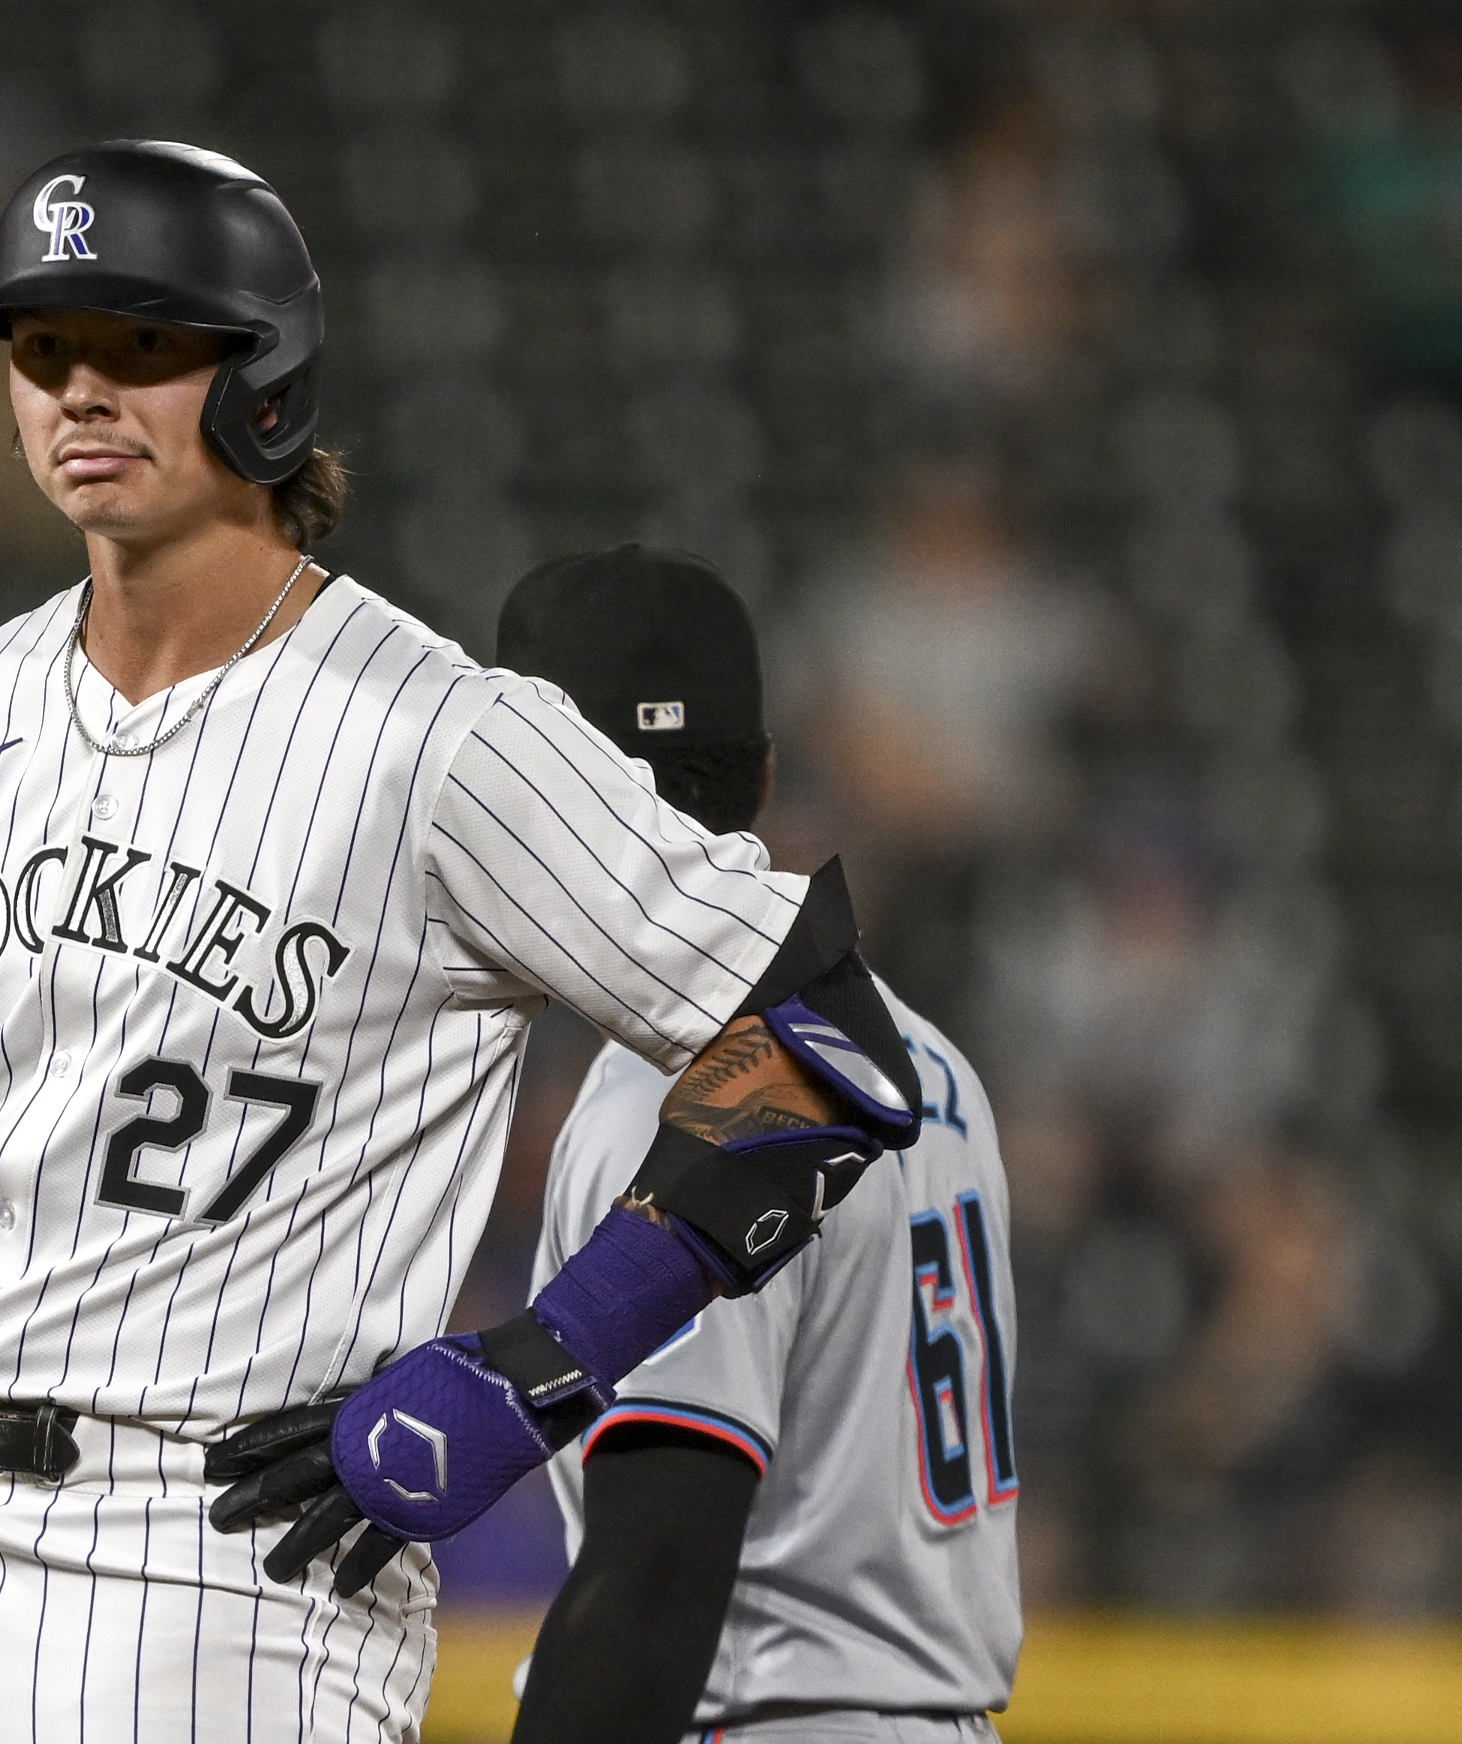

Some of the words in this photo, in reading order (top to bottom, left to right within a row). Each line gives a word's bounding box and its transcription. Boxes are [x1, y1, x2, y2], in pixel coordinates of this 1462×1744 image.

[33, 174, 97, 262] CR
[93, 1054, 324, 1227] 27
[906, 1190, 1018, 1525] 61
